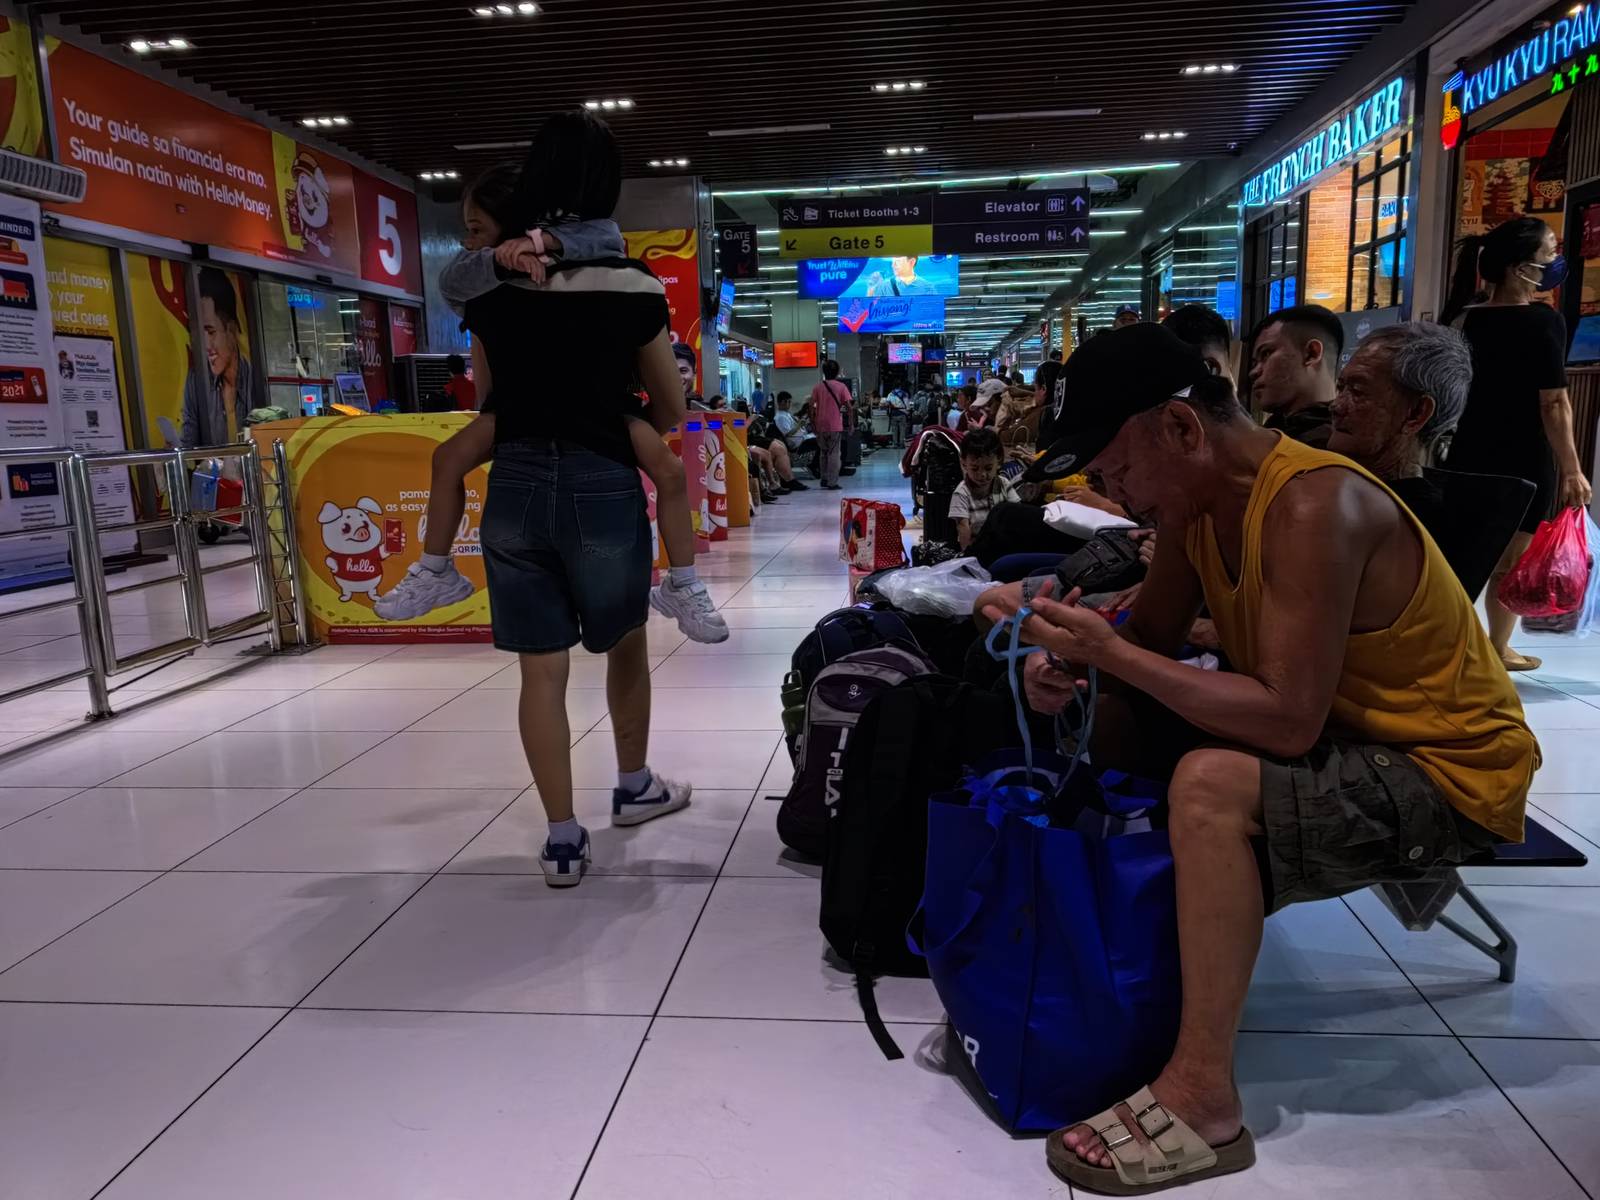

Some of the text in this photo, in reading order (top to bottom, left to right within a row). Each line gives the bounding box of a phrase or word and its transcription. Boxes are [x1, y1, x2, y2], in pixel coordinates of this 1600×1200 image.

[1463, 59, 1501, 114] KYU
[1504, 30, 1549, 91] KYU
[63, 97, 267, 188] Your guide sa financial era mo.
[1243, 76, 1404, 205] THE FRENCH BAKER
[69, 136, 133, 176] Simulan
[136, 162, 173, 187] natin
[175, 173, 204, 196] with
[205, 179, 273, 221] HelloMoney.
[828, 206, 920, 219] Ticket Booths 1-3
[984, 201, 1040, 214] Elevator
[377, 194, 402, 275] 5
[975, 231, 1040, 243] Restroom
[741, 240, 751, 253] 5
[829, 235, 884, 249] Gate 5
[807, 261, 827, 270] Trust
[70, 273, 111, 292] money
[820, 271, 847, 283] pure
[57, 290, 85, 305] your
[80, 313, 109, 327] ones
[2, 384, 25, 397] 2021
[385, 502, 398, 512] as
[401, 502, 427, 513] easy
[346, 557, 375, 573] hello
